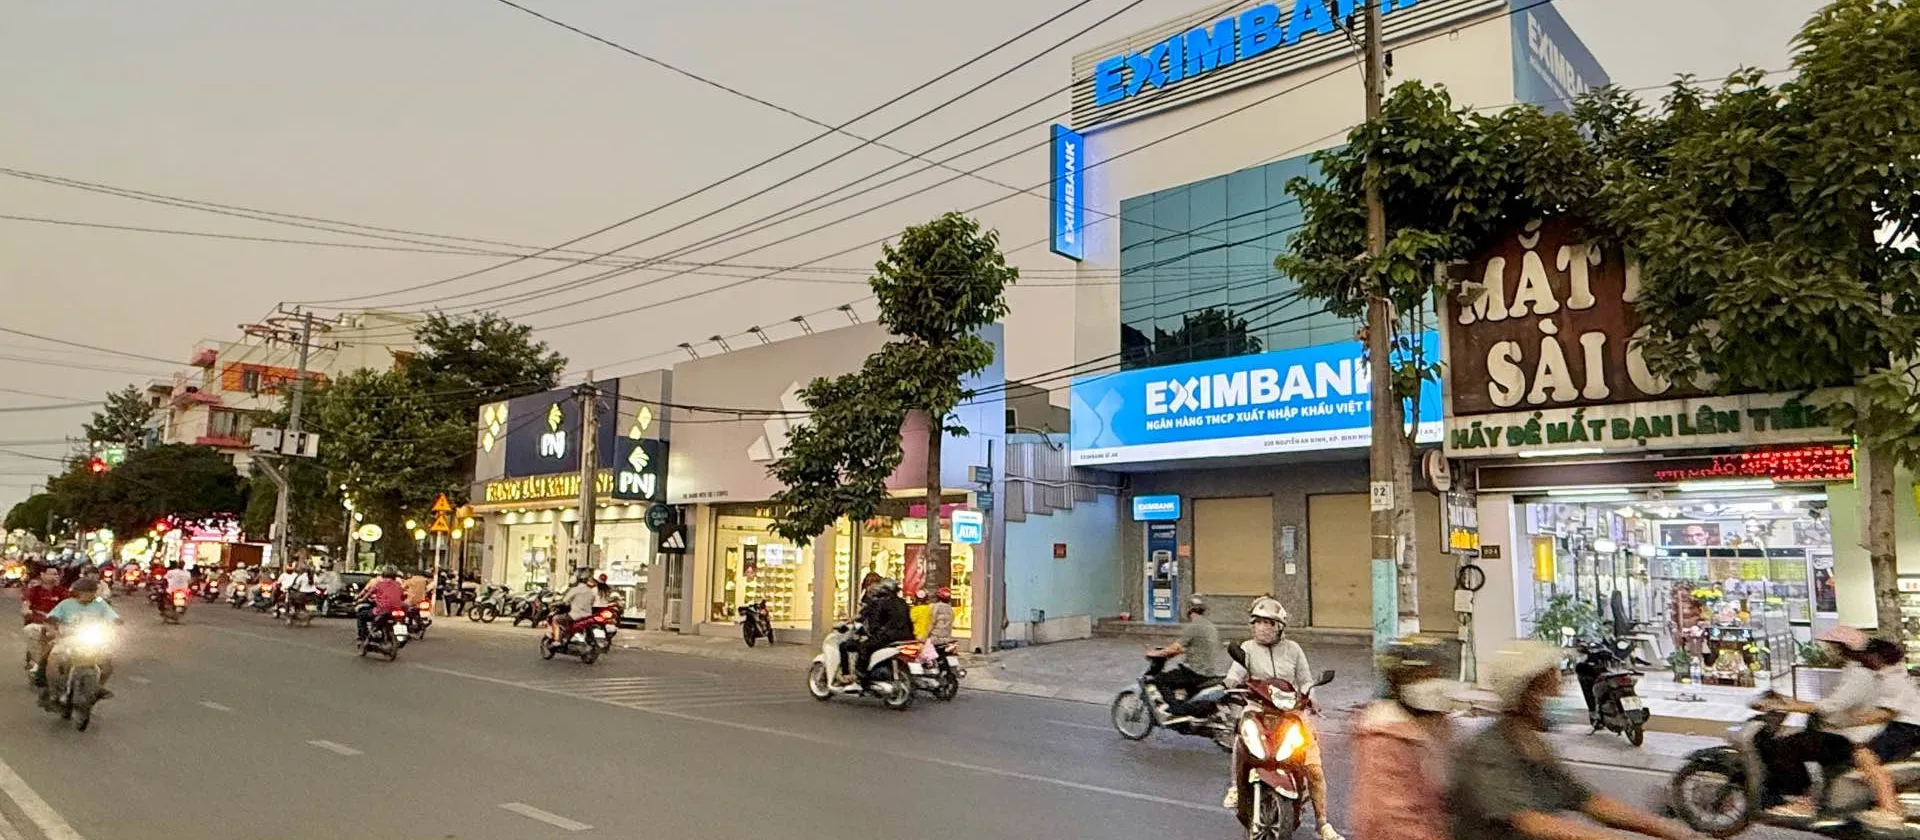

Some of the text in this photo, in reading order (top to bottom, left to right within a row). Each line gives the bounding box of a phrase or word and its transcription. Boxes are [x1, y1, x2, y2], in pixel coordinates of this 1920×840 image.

[1095, 0, 1418, 106] EXIMBA
[1064, 140, 1075, 244] EXIMBANK
[1487, 318, 1610, 407] SÀI
[1146, 417, 1173, 431] NGÂN
[1175, 414, 1203, 429] HÀNG
[1206, 411, 1234, 425] TMCP
[1236, 407, 1265, 422] XUẤT
[1267, 405, 1299, 421] NHẬP
[1336, 399, 1364, 416] VIỆT
[1450, 421, 1502, 449] HÃY
[1507, 411, 1543, 446] ĐỂ
[1546, 407, 1606, 443] MẮT
[1611, 415, 1673, 446] BẠN
[1677, 404, 1740, 436] LÊN
[541, 430, 566, 459] PNJ
[618, 470, 657, 500] PNJ
